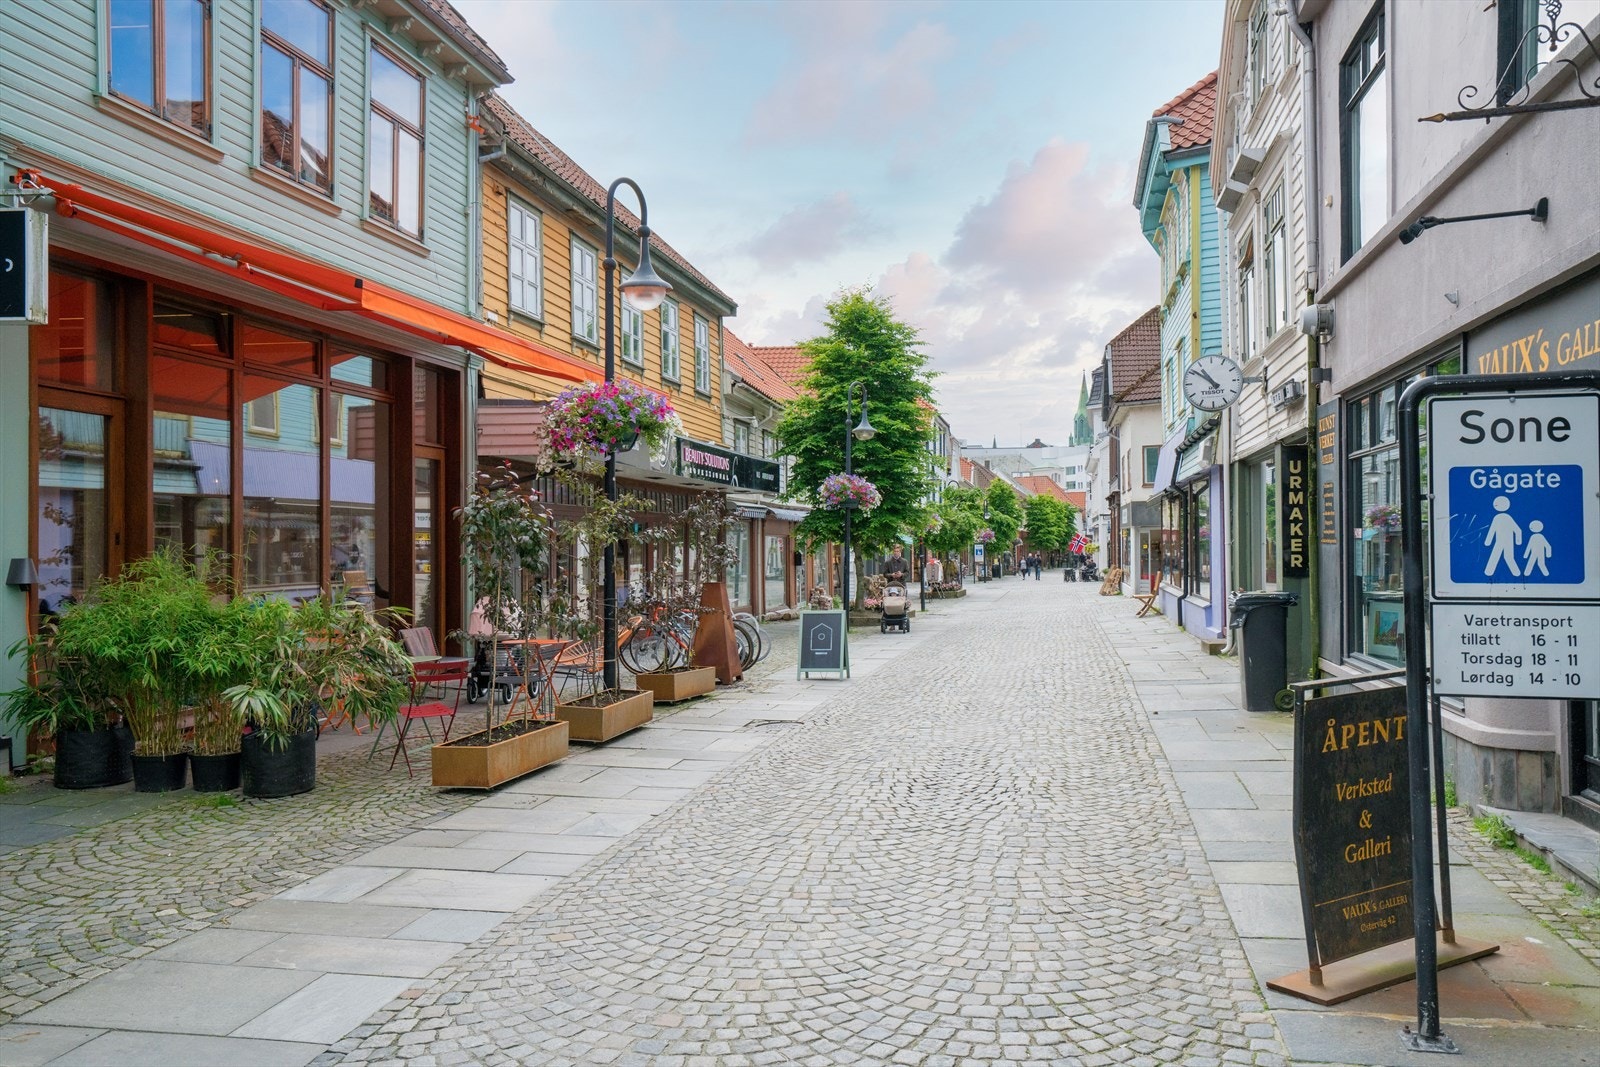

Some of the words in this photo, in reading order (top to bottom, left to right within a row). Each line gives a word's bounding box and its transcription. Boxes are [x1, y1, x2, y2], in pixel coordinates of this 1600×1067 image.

[1459, 409, 1571, 444] Sone
[683, 447, 705, 465] BEAUTY
[704, 452, 730, 471] SOLUTIONS
[1470, 468, 1561, 494] Gågate
[1288, 460, 1304, 568] URMAKER
[1464, 614, 1573, 630] Varetransport
[1461, 633, 1501, 646] tillatt
[1531, 634, 1546, 647] 16
[1567, 635, 1578, 647] 11
[1461, 652, 1523, 668] Torsdag
[1531, 653, 1547, 666] 18
[1567, 654, 1578, 666] 11
[1461, 671, 1514, 687] Lørdag
[1529, 672, 1544, 685] 14
[1565, 673, 1581, 686] 10
[1321, 715, 1407, 753] ÅPENT
[1336, 772, 1393, 802] Verksted
[1359, 809, 1373, 829] &
[1345, 835, 1392, 864] Galleri
[1379, 894, 1408, 910] GALLERI
[1387, 915, 1397, 924] 42
